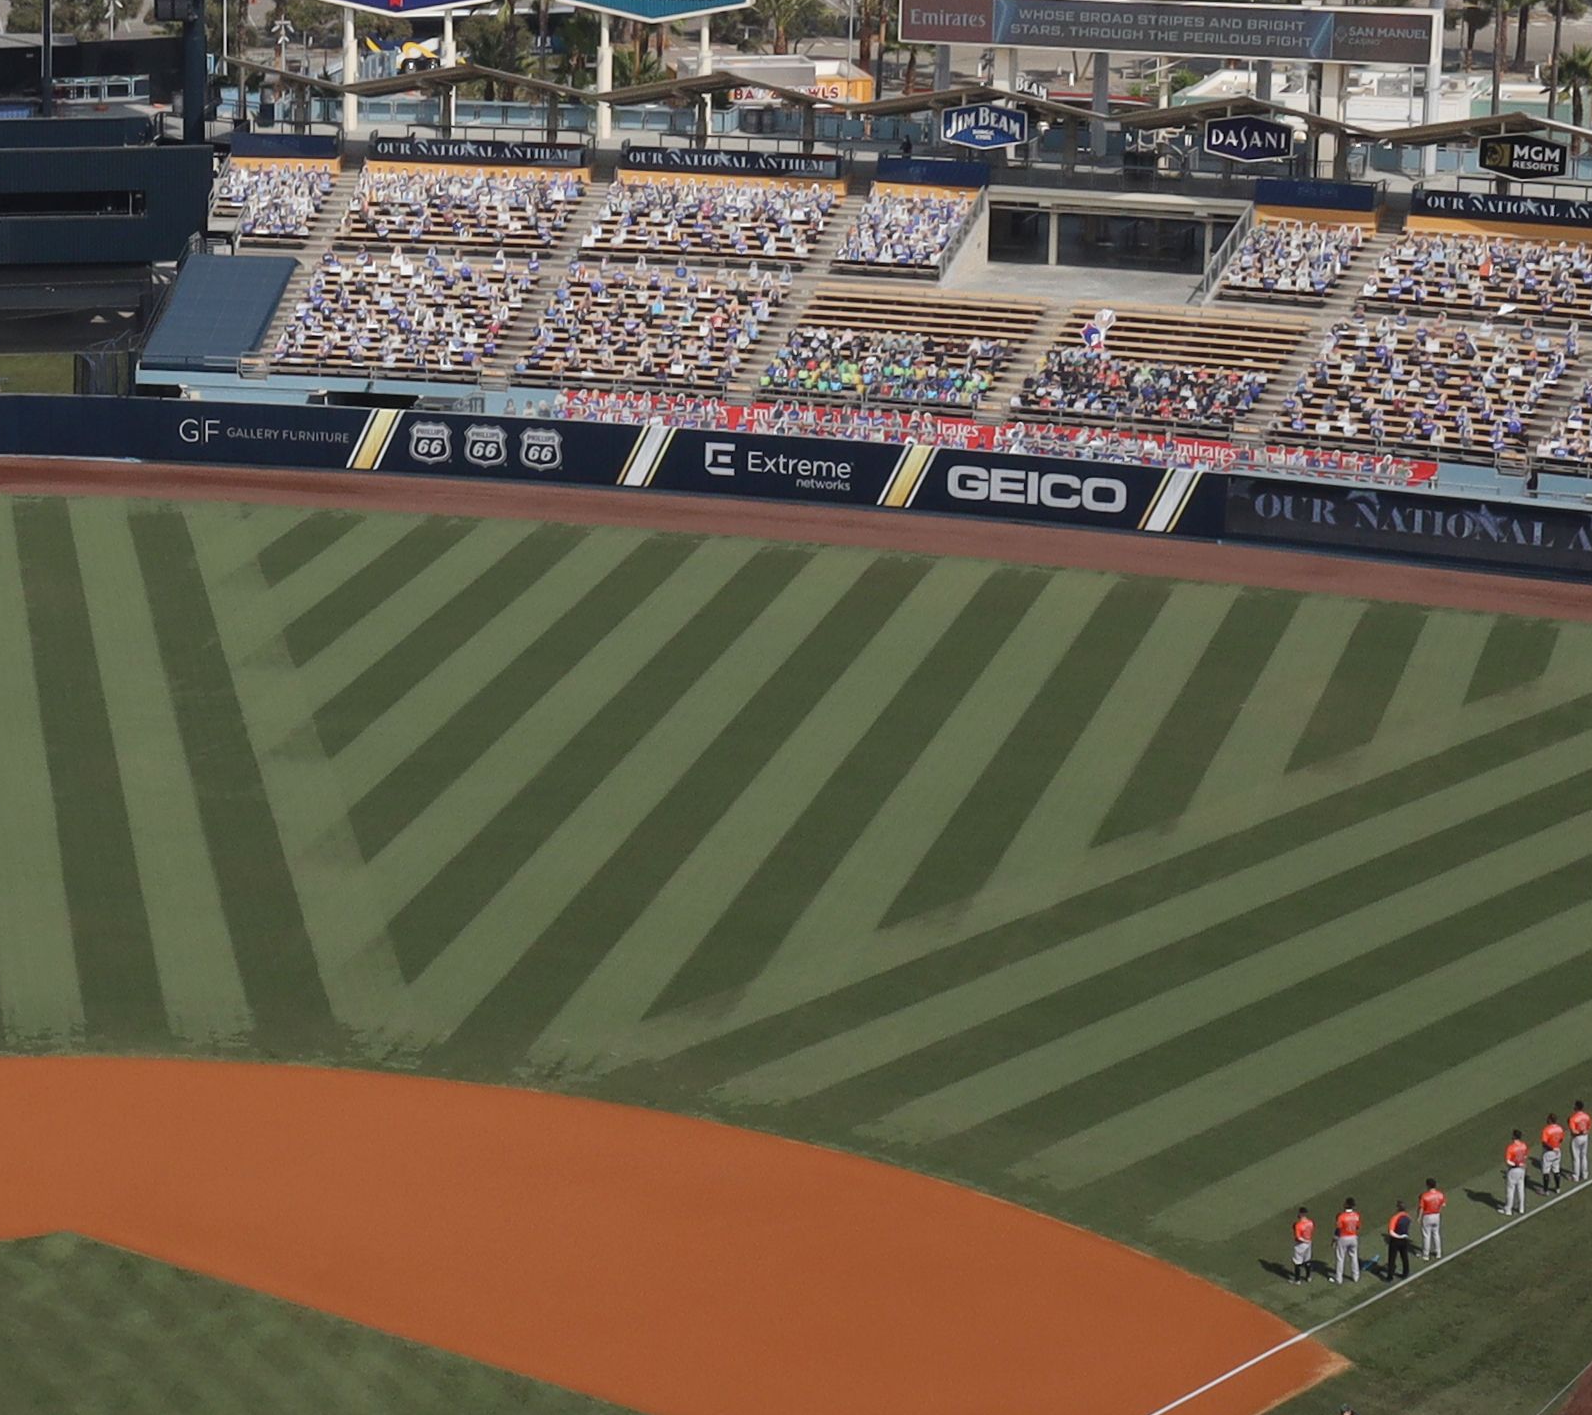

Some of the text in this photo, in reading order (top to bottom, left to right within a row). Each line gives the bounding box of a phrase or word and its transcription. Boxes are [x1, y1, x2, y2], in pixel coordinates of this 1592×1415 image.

[910, 9, 986, 28] Emirates
[1019, 9, 1304, 32] WHOSE BROAD STRIPES AND BRIGHT
[1011, 23, 1312, 48] STARS, THROUGH THE PERILOUS FIGHT
[1349, 26, 1429, 41] SAN MANUEL
[946, 111, 976, 138] JIM
[979, 107, 1020, 140] BEAM
[1211, 125, 1286, 149] DASANI
[377, 141, 568, 161] OUR NATIONAL ANTHEM
[629, 149, 825, 172] OUR NATIONAL ANTHEM
[1513, 144, 1560, 162] MGM
[1513, 161, 1559, 173] RESORTS
[1427, 195, 1464, 210] OUR
[1471, 197, 1560, 220] NATIONAL
[227, 427, 278, 440] GALLERY
[283, 429, 349, 444] FURNITURE
[417, 438, 442, 454] 66
[472, 441, 497, 457] 66
[528, 444, 553, 460] 66
[748, 451, 851, 478] Extreme
[796, 477, 850, 493] networks
[947, 466, 1127, 513] GEICO
[1255, 492, 1336, 525] OUR
[1356, 502, 1554, 547] NATIONAL
